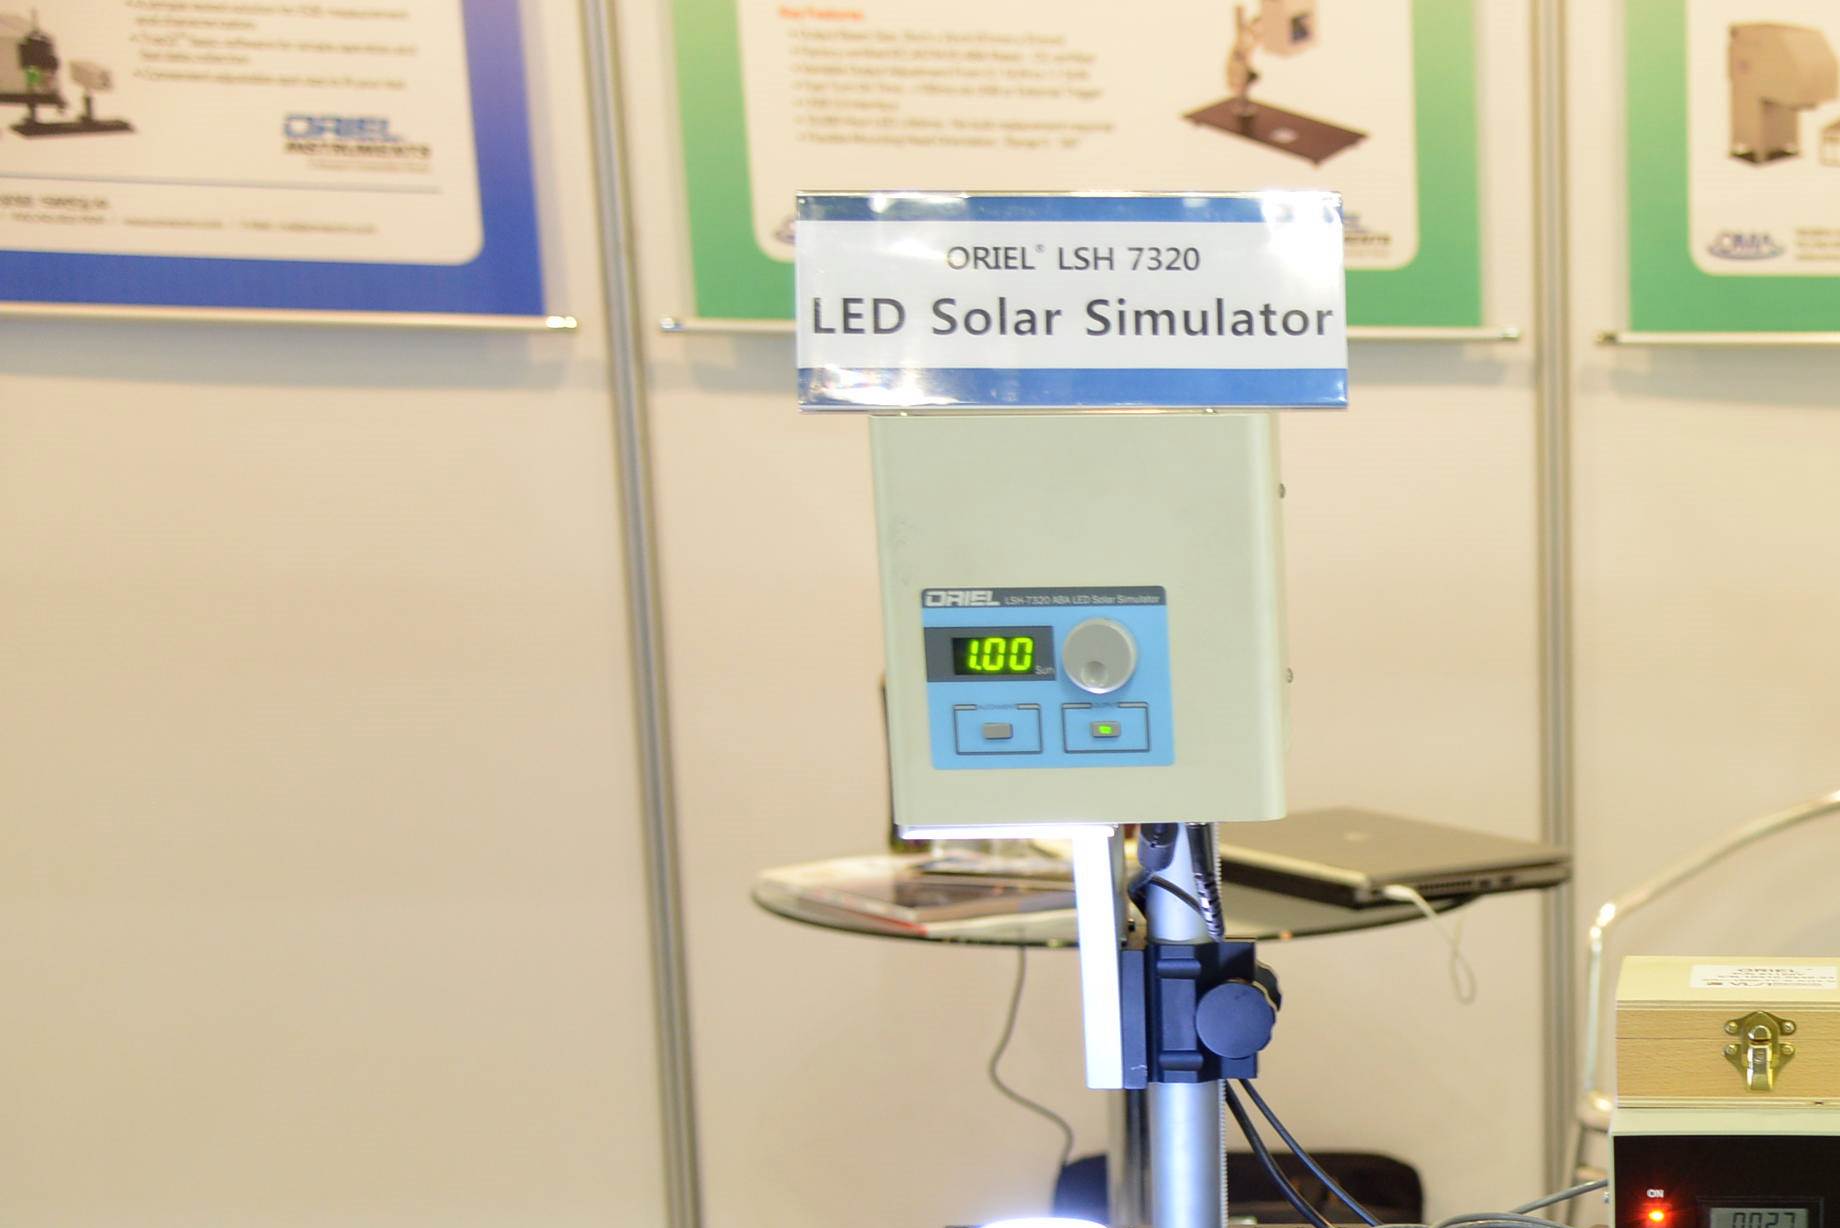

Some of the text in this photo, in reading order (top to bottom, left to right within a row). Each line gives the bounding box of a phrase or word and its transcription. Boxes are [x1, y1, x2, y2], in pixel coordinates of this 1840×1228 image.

[1058, 247, 1115, 270] LSH
[1129, 247, 1201, 271] 7320
[812, 297, 1334, 337] LED Solar Simulator
[924, 590, 1000, 607] ORIEL
[968, 636, 1034, 671] 1.00
[1647, 1189, 1664, 1198] ON
